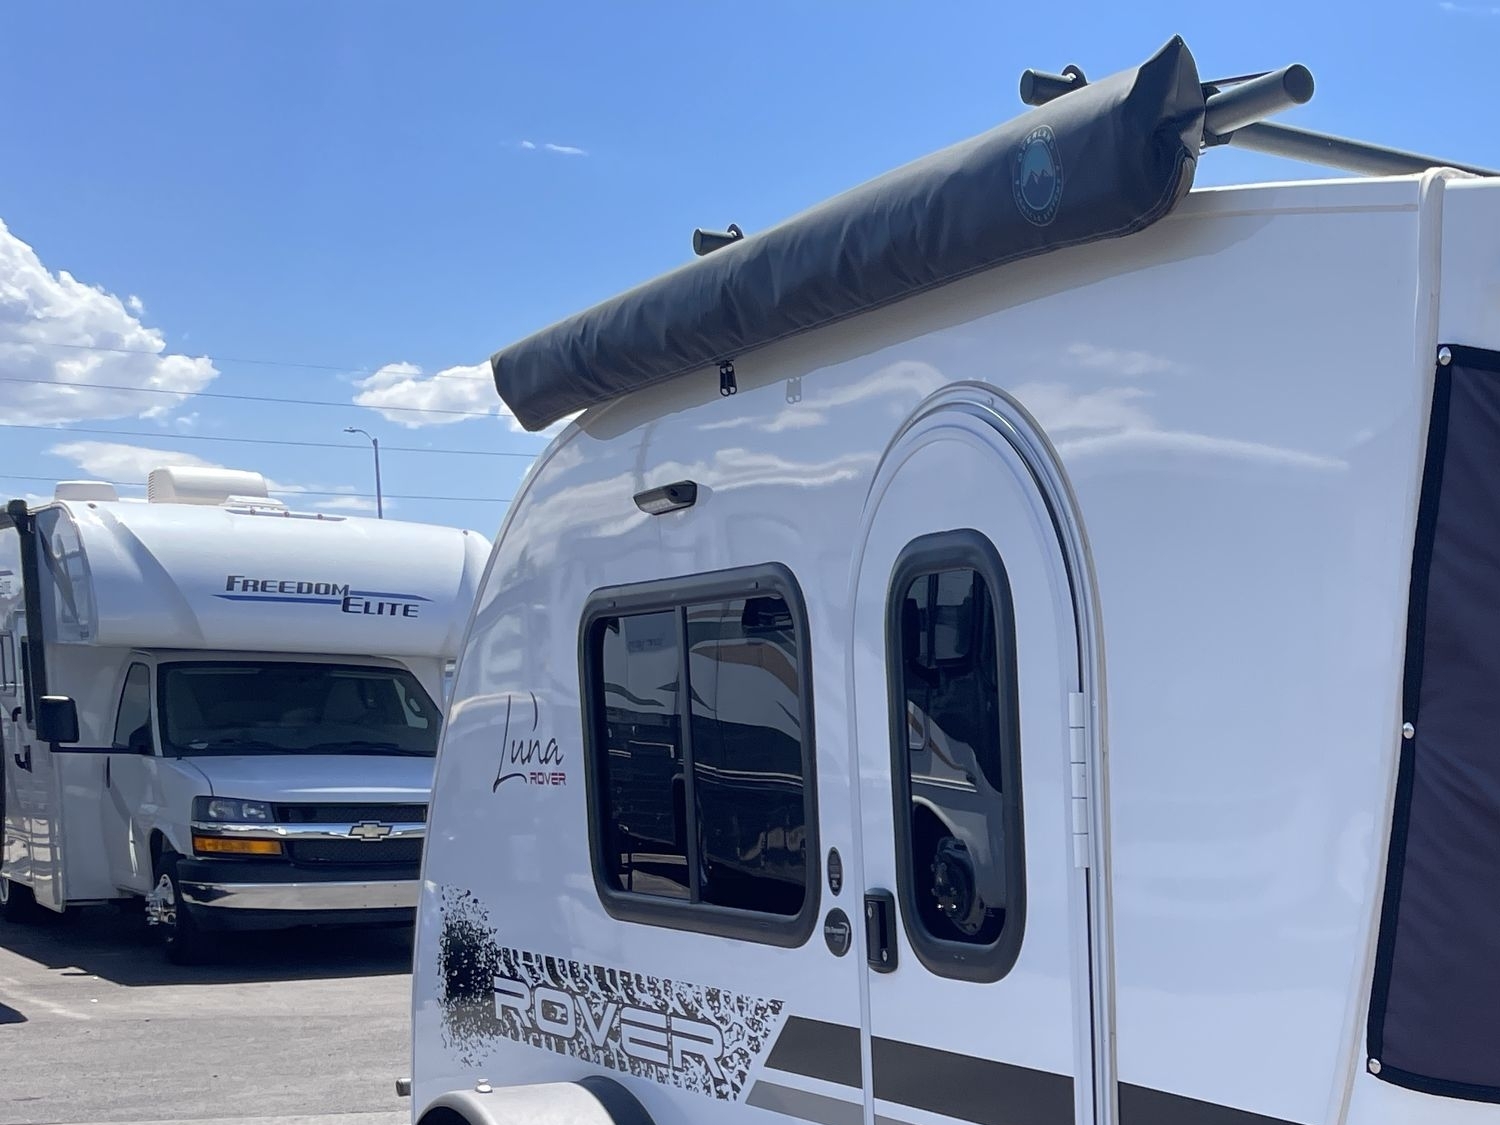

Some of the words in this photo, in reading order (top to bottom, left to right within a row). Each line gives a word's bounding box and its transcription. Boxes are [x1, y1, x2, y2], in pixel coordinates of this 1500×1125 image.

[226, 575, 350, 597] FREEDOM
[342, 596, 419, 618] ELITE
[493, 691, 564, 793] Luna
[530, 772, 566, 786] ROVER
[494, 976, 724, 1079] ROVER
